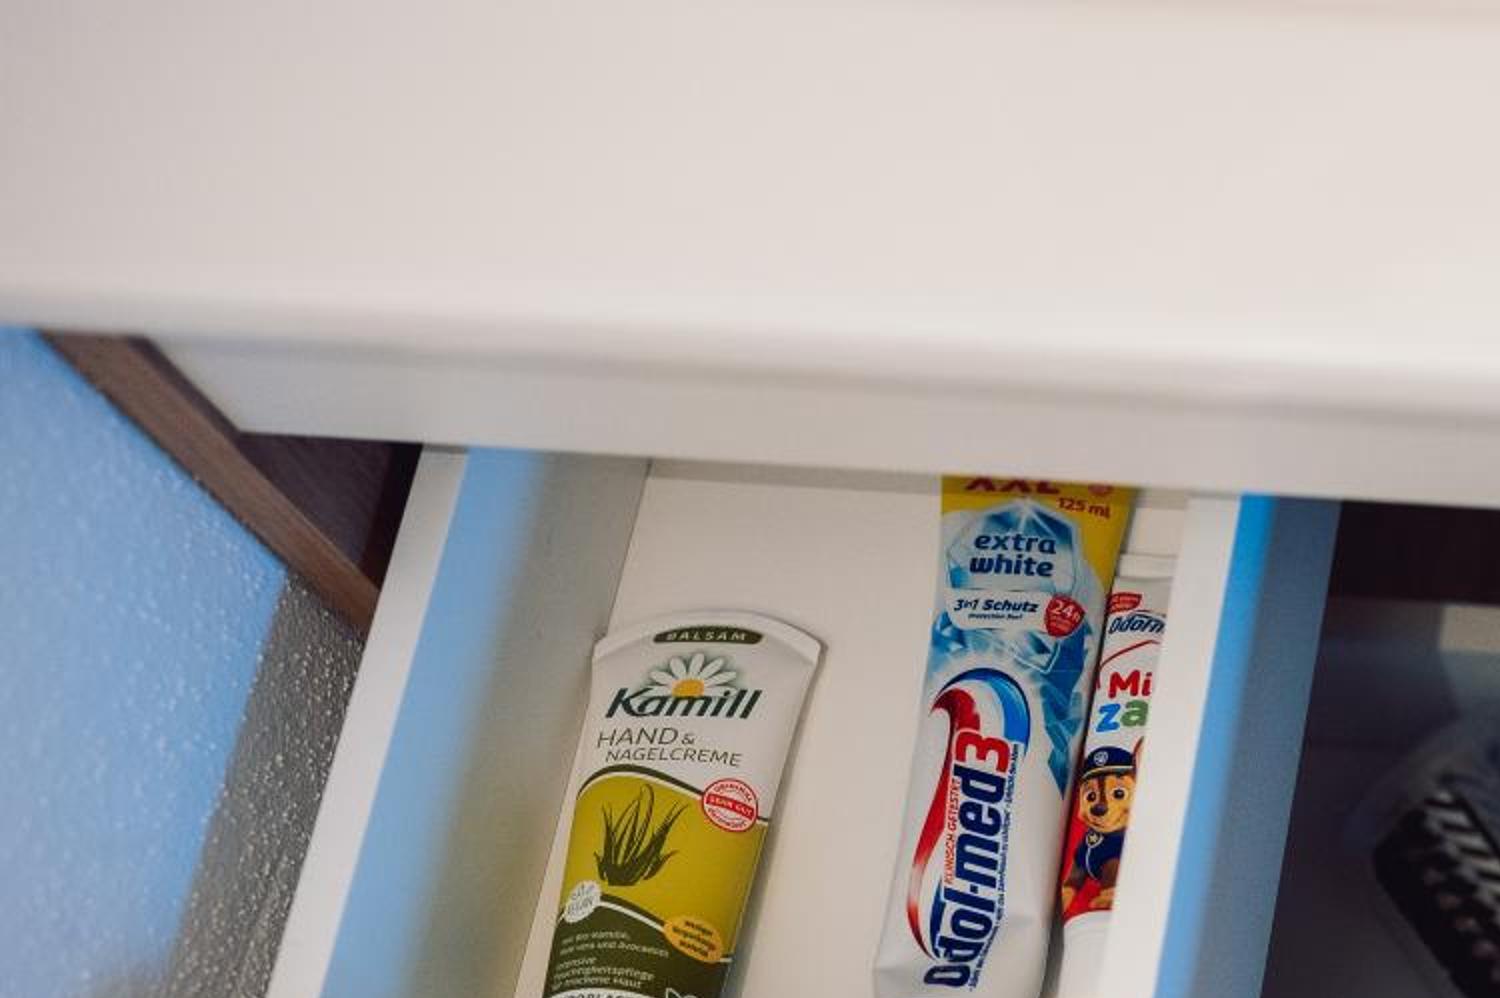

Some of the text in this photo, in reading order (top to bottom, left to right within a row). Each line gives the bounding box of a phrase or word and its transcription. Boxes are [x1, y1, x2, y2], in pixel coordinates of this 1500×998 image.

[1058, 497, 1111, 519] 125 ml
[974, 533, 1057, 555] extra
[969, 554, 1055, 577] white
[982, 599, 1040, 613] Schutz
[665, 630, 747, 642] BALSAM
[1107, 669, 1153, 699] Mi
[604, 687, 763, 720] Kamill
[1095, 699, 1149, 733] za
[596, 727, 698, 749] HAND &
[604, 747, 743, 768] NAGELCREME
